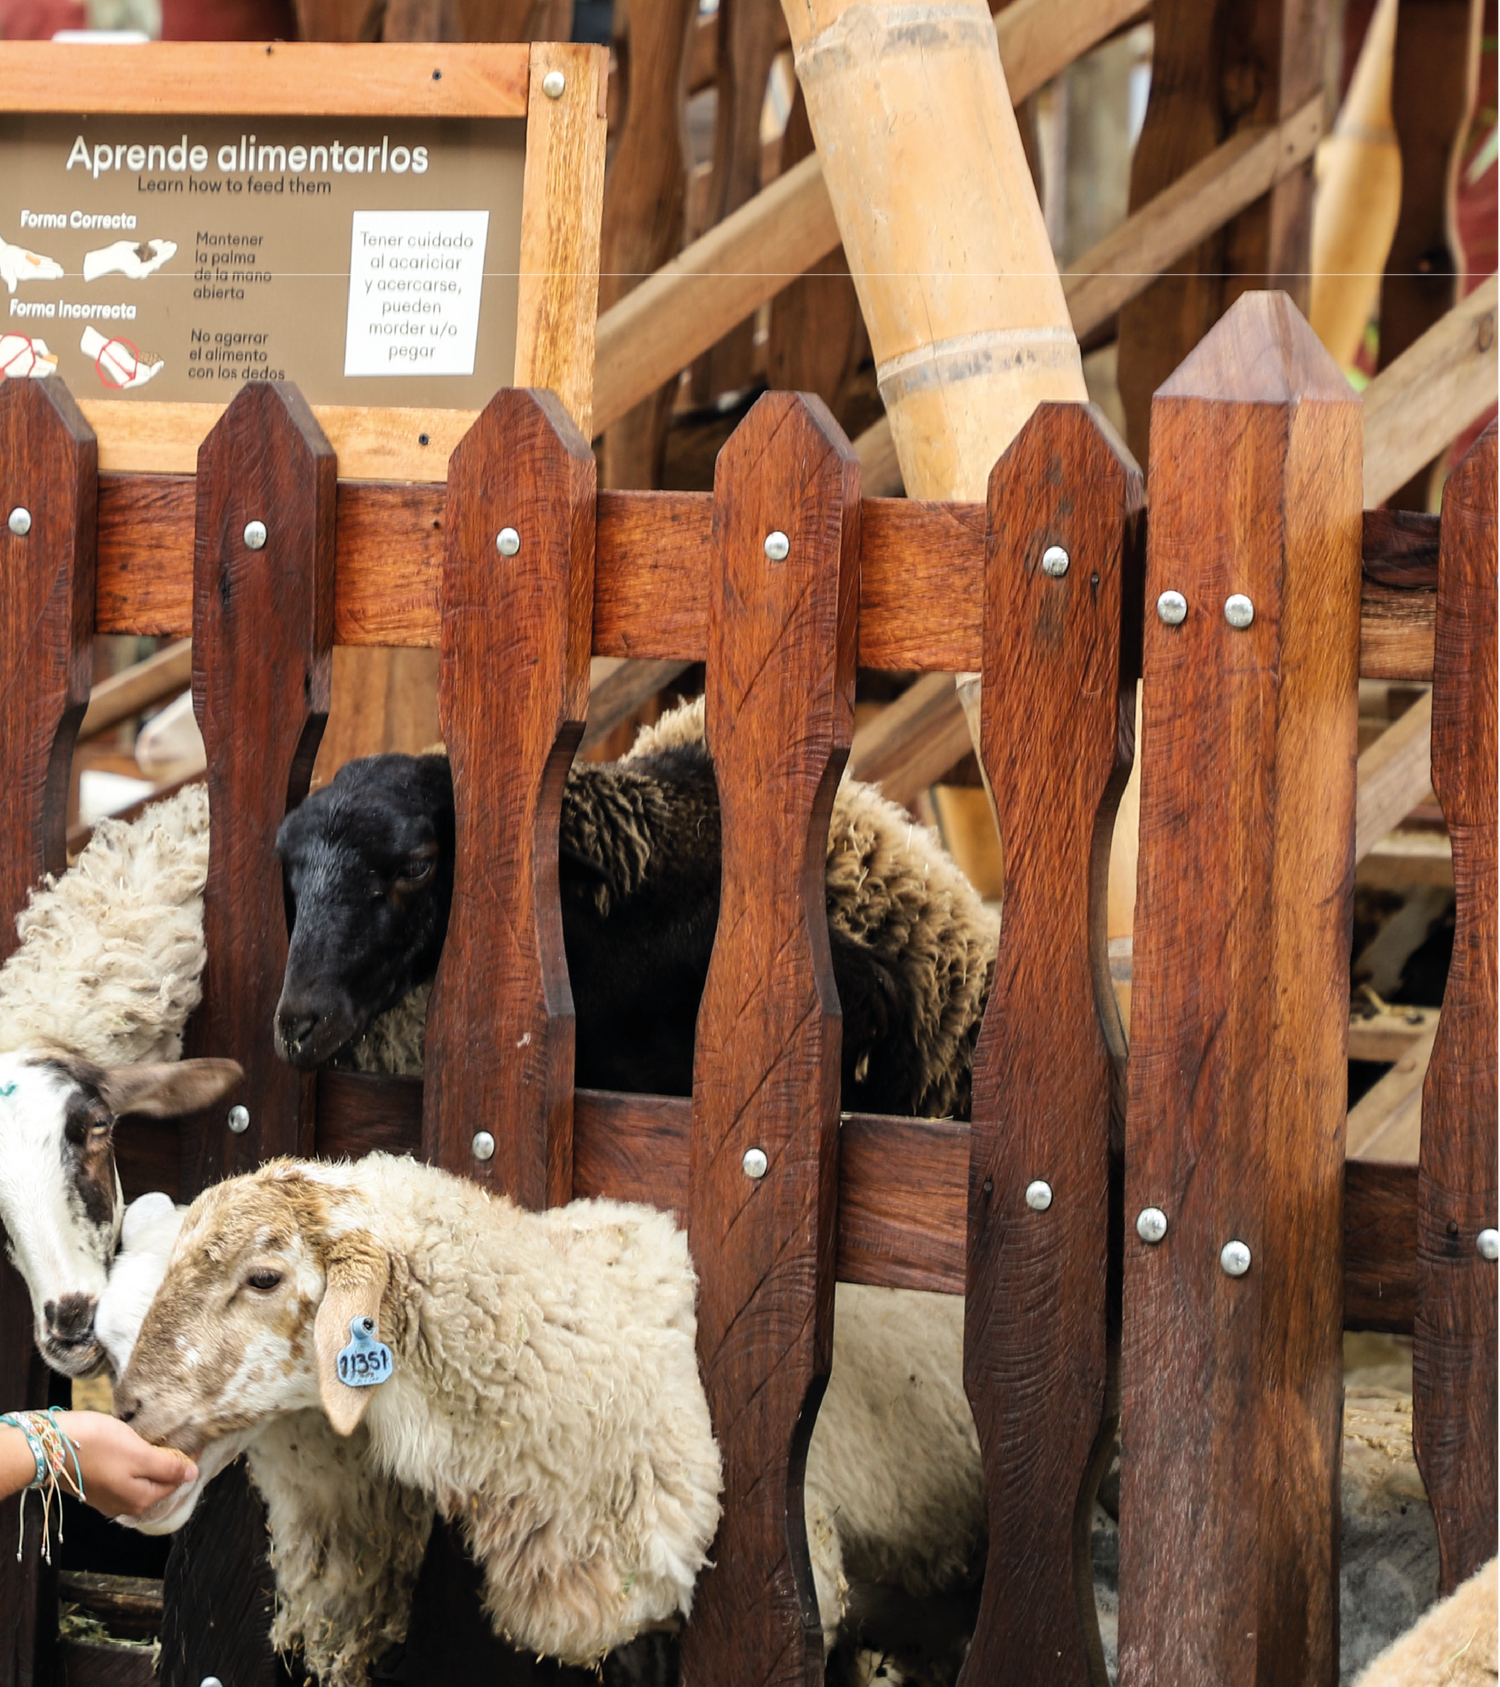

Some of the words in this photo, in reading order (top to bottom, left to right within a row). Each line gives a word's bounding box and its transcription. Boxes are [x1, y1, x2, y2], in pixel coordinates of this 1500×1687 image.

[66, 134, 209, 179] Aprende
[217, 134, 429, 174] alimentarlos
[138, 176, 184, 192] Learn
[189, 176, 222, 193] how
[226, 178, 242, 192] to
[247, 176, 284, 193] feed
[289, 177, 331, 194] them
[20, 209, 67, 229] Forma
[69, 210, 137, 230] Correcta
[196, 231, 264, 246] Mantener
[360, 230, 403, 247] Tener
[407, 230, 474, 248] cuidado
[195, 249, 208, 264] la
[211, 249, 256, 267] palma
[370, 252, 385, 269] al
[389, 252, 462, 270] acariciar
[194, 266, 212, 281] de
[215, 266, 228, 281] la
[232, 270, 272, 282] mano
[193, 284, 245, 299] abierta
[364, 279, 373, 296] y
[377, 278, 462, 296] acercarse,
[10, 298, 56, 317] Forma
[58, 299, 137, 320] Incorrecta
[382, 297, 442, 317] pueden
[190, 328, 211, 343] No
[214, 332, 269, 347] agarrar
[369, 319, 426, 336] morder
[429, 319, 458, 339] u/o
[189, 346, 202, 361] el
[205, 346, 268, 362] alimento
[388, 345, 436, 362] pegar
[188, 367, 214, 379] con
[218, 364, 237, 379] los
[241, 365, 285, 380] dedos
[339, 1347, 388, 1379] 11351
